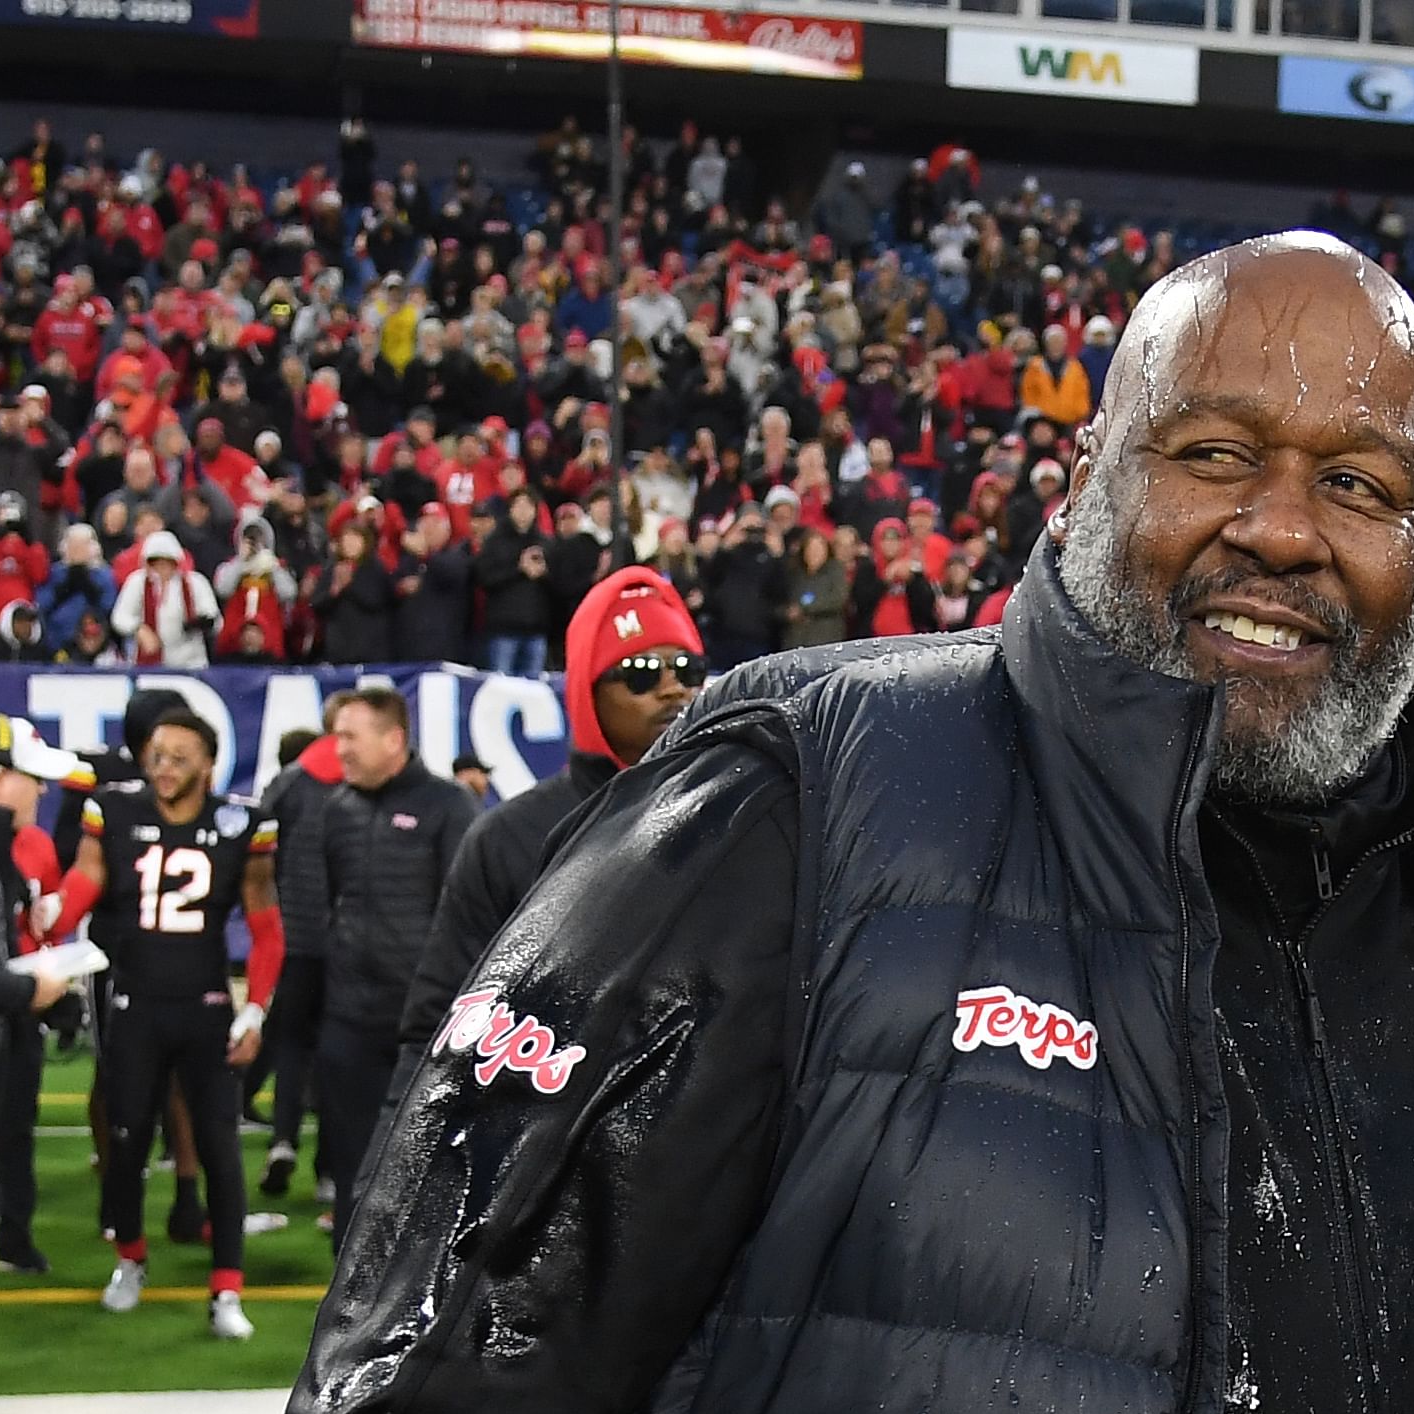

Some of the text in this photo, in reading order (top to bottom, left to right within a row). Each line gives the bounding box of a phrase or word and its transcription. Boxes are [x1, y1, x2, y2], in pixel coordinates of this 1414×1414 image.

[1018, 45, 1126, 84] WM
[613, 608, 644, 641] M
[132, 843, 213, 933] 12
[431, 980, 588, 1096] Terps
[952, 984, 1099, 1071] Terps
